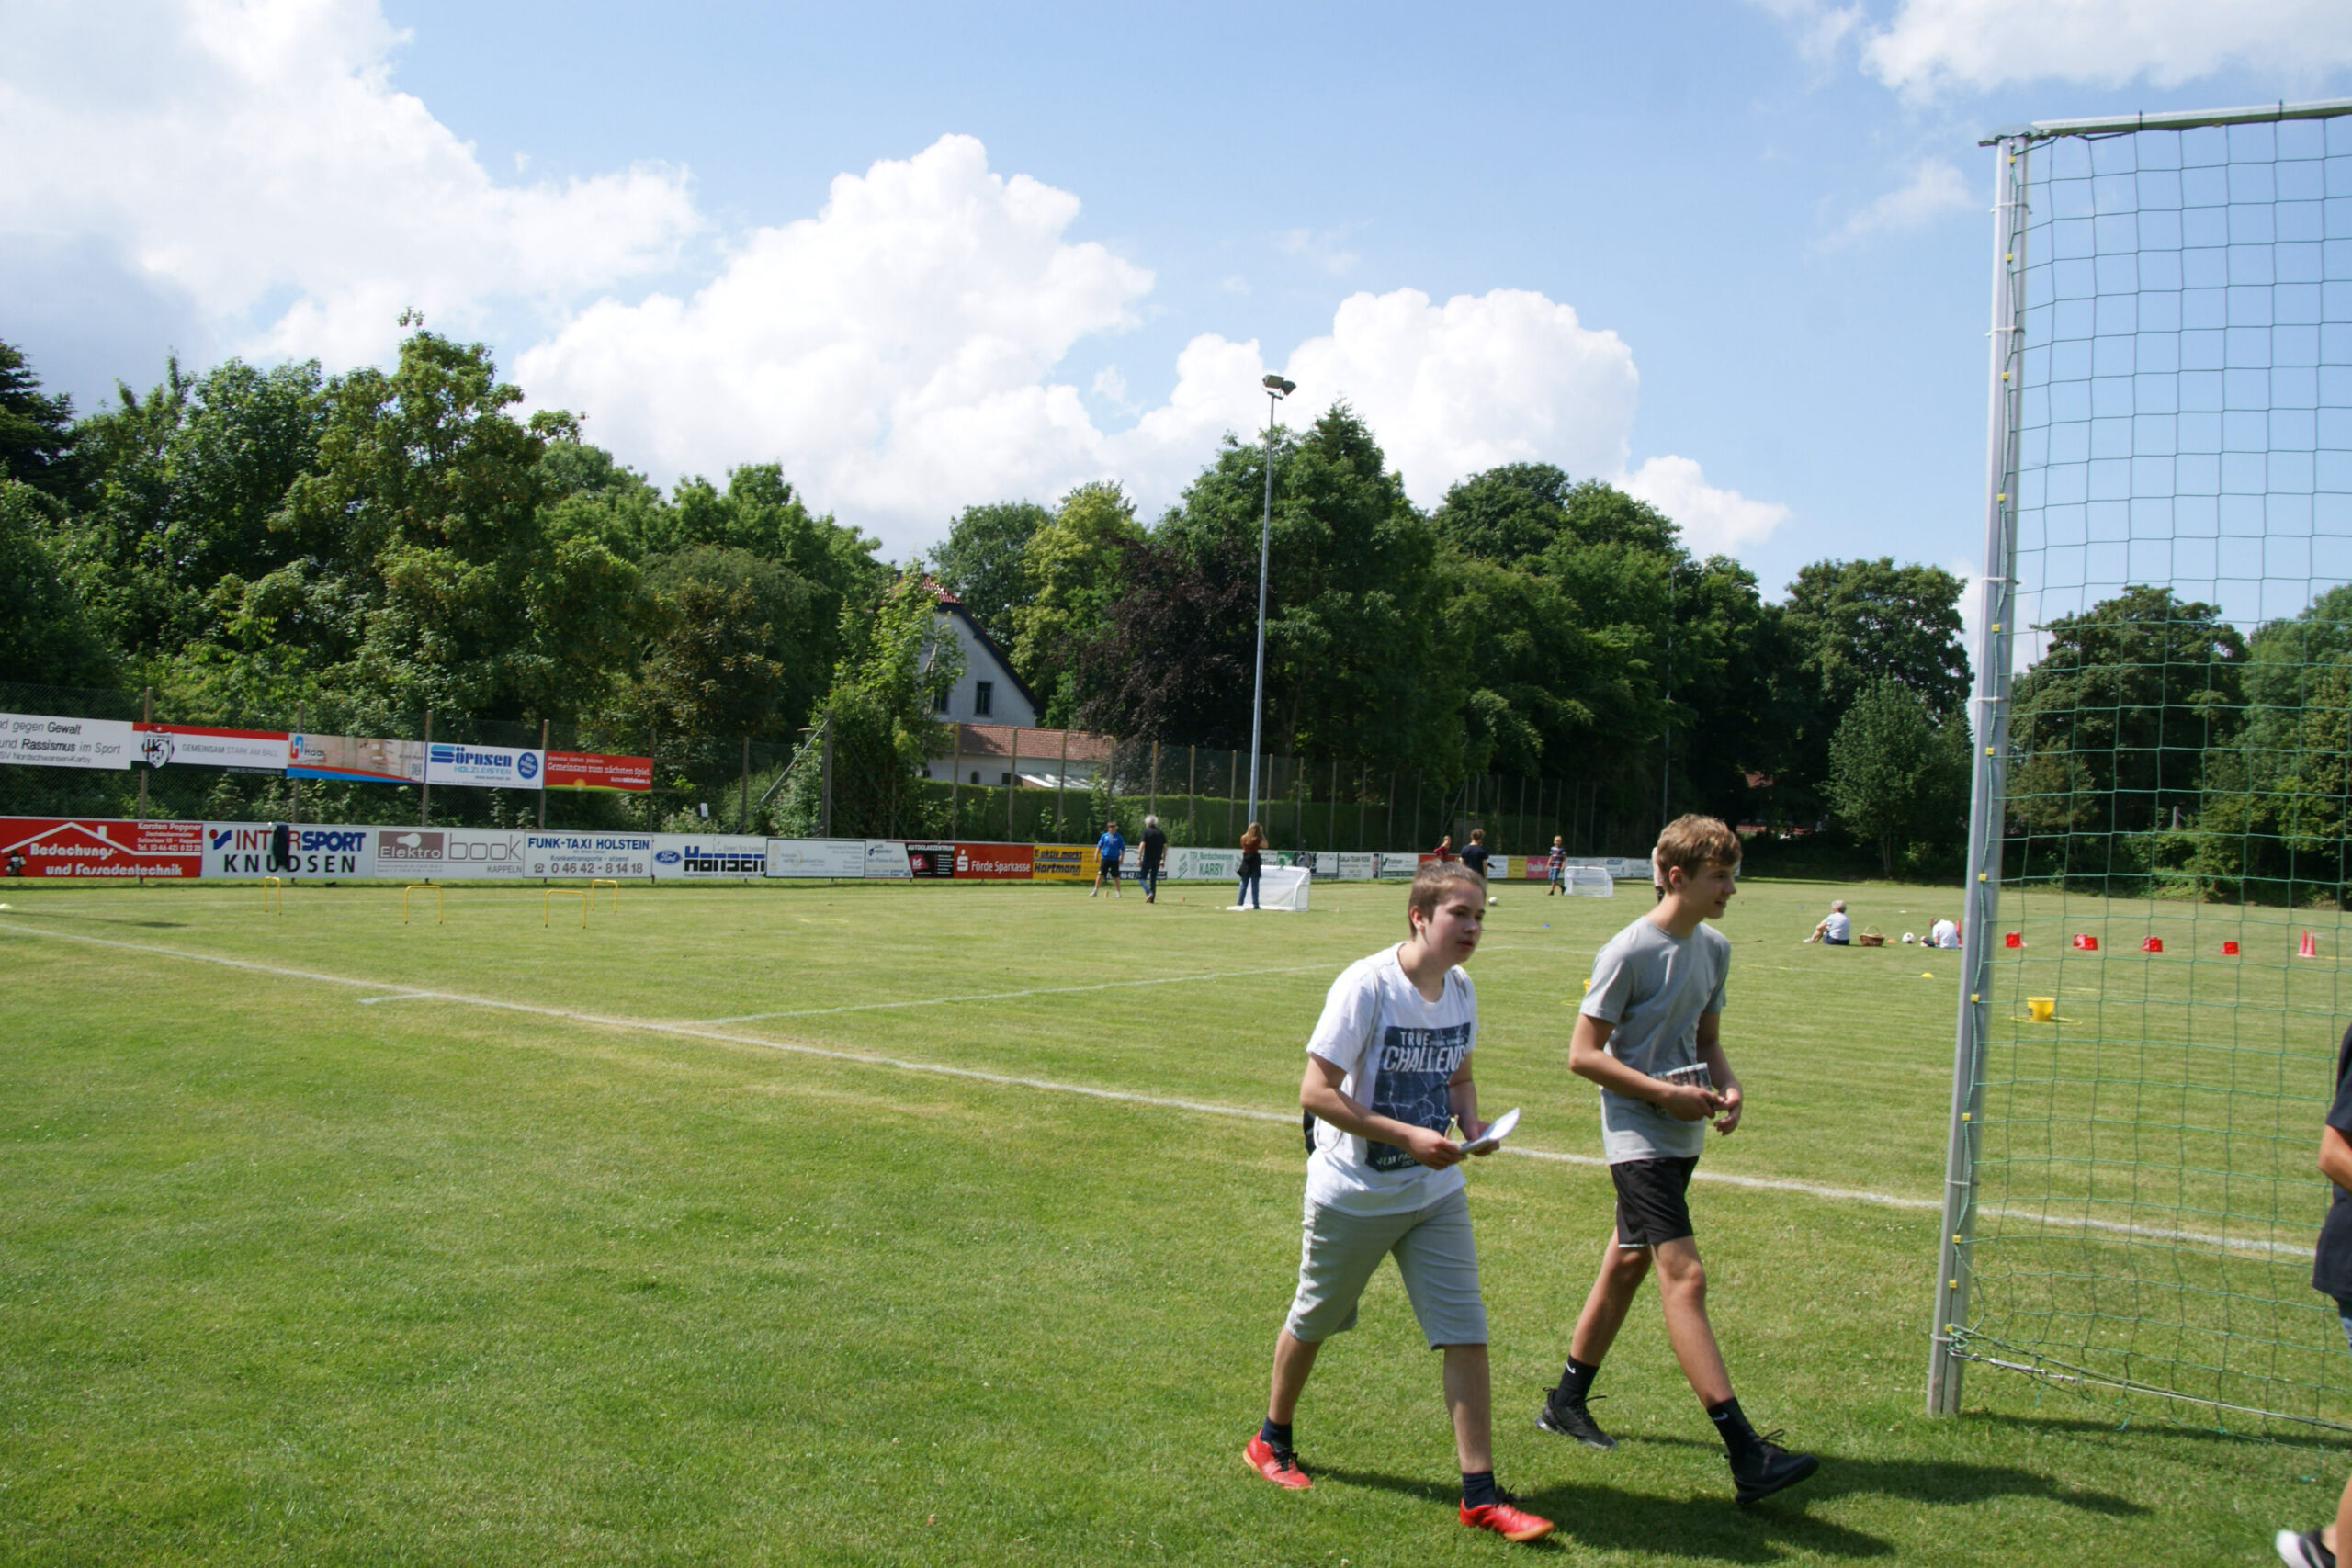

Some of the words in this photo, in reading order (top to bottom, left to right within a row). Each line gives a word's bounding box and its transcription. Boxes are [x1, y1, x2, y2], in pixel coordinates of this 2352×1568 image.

[13, 721, 44, 733] gegen
[47, 721, 81, 735] Gewalt
[21, 738, 76, 752] Rassismus
[79, 742, 92, 752] im
[95, 742, 121, 755] Sport
[182, 743, 225, 753] GEMEINSAM
[226, 745, 247, 754] STARK
[250, 747, 261, 756] AM
[262, 748, 277, 757] BALL
[454, 766, 512, 775] HOLZLEISTEN
[548, 762, 587, 773] Gemeinsam
[588, 765, 603, 773] zum
[605, 766, 633, 775] nächsten
[236, 829, 367, 852] INTRSPORT
[448, 833, 522, 861] book
[528, 837, 592, 850] FUNK-TAXI
[596, 839, 650, 850] HOLSTEIN
[29, 843, 118, 860] Bedachungs-
[379, 846, 442, 859] Elektro
[660, 852, 677, 862] Ford
[45, 863, 72, 875] und
[224, 854, 356, 873] KNUDSEN
[551, 863, 559, 873] 0
[562, 863, 576, 873] 46
[580, 863, 594, 873] 42
[605, 863, 613, 873] 8
[616, 863, 628, 874] 14
[631, 863, 643, 874] 18
[971, 860, 992, 872] Förde
[994, 861, 1031, 874] Sparkasse
[1199, 863, 1224, 875] KARBY
[1400, 1032, 1430, 1046] TRUE
